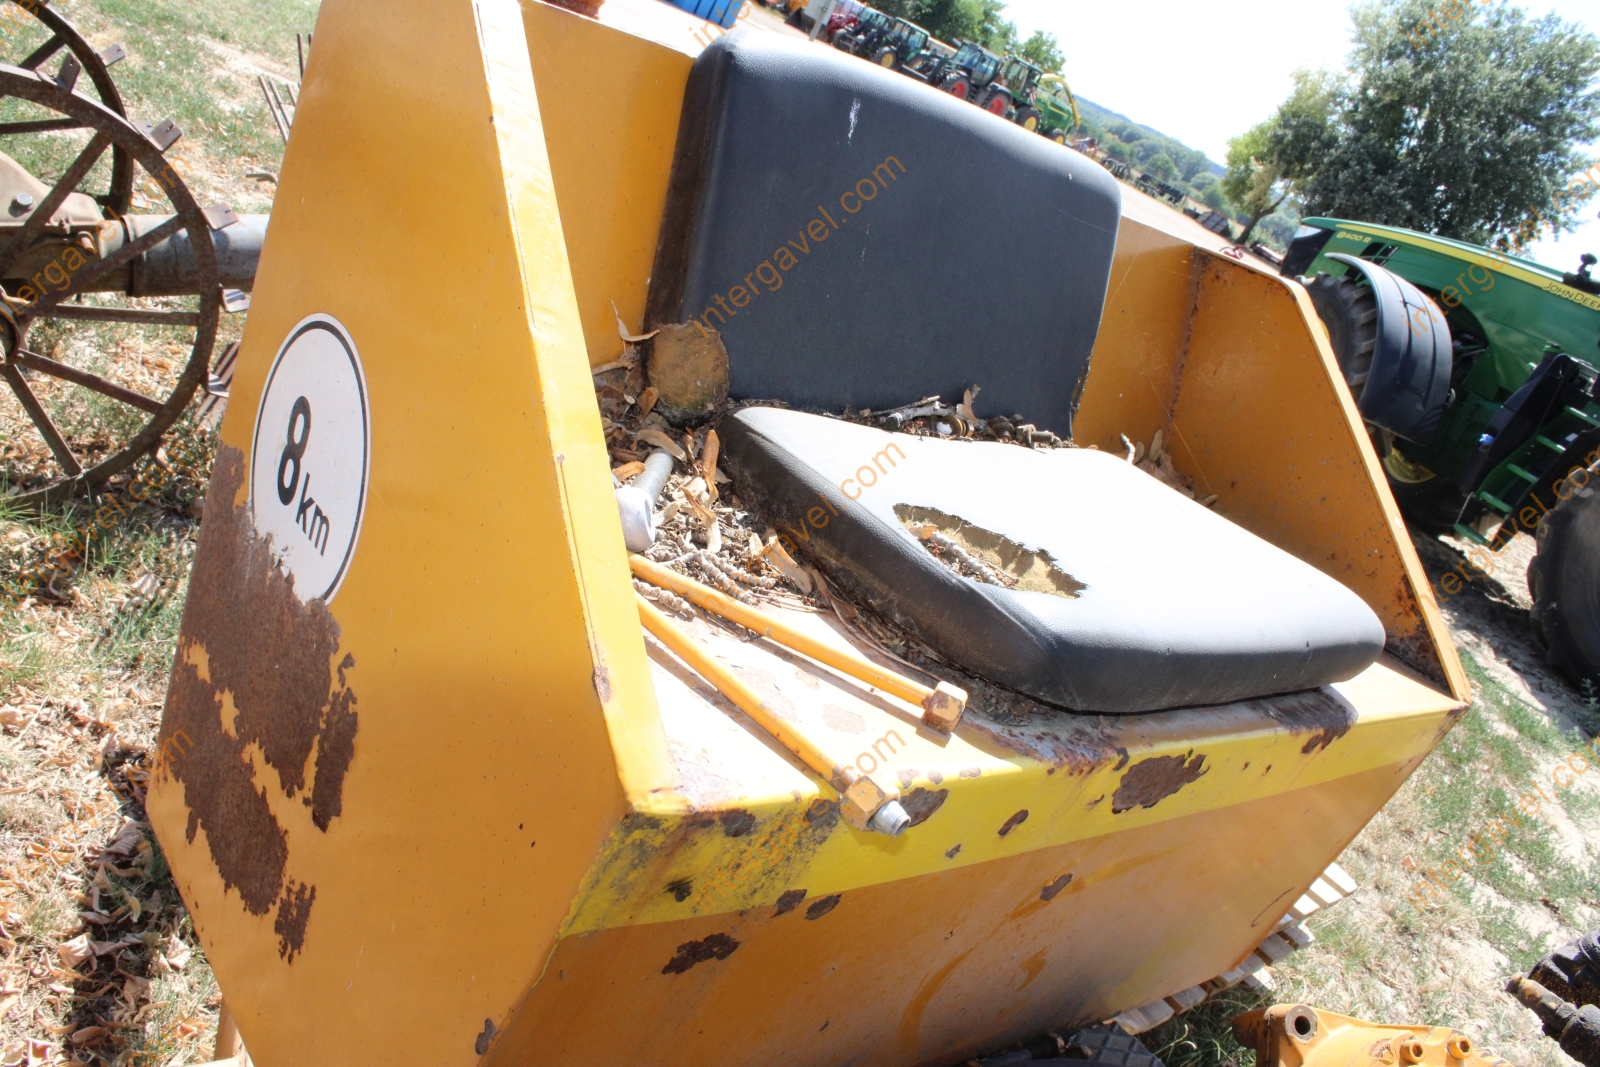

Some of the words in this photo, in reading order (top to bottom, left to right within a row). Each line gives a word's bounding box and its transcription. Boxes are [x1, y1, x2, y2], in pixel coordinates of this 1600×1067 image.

[1336, 231, 1364, 242] 8400
[1543, 282, 1575, 300] JOHN
[1573, 292, 1600, 310] DEE
[277, 395, 312, 506] 8
[295, 471, 330, 558] km
